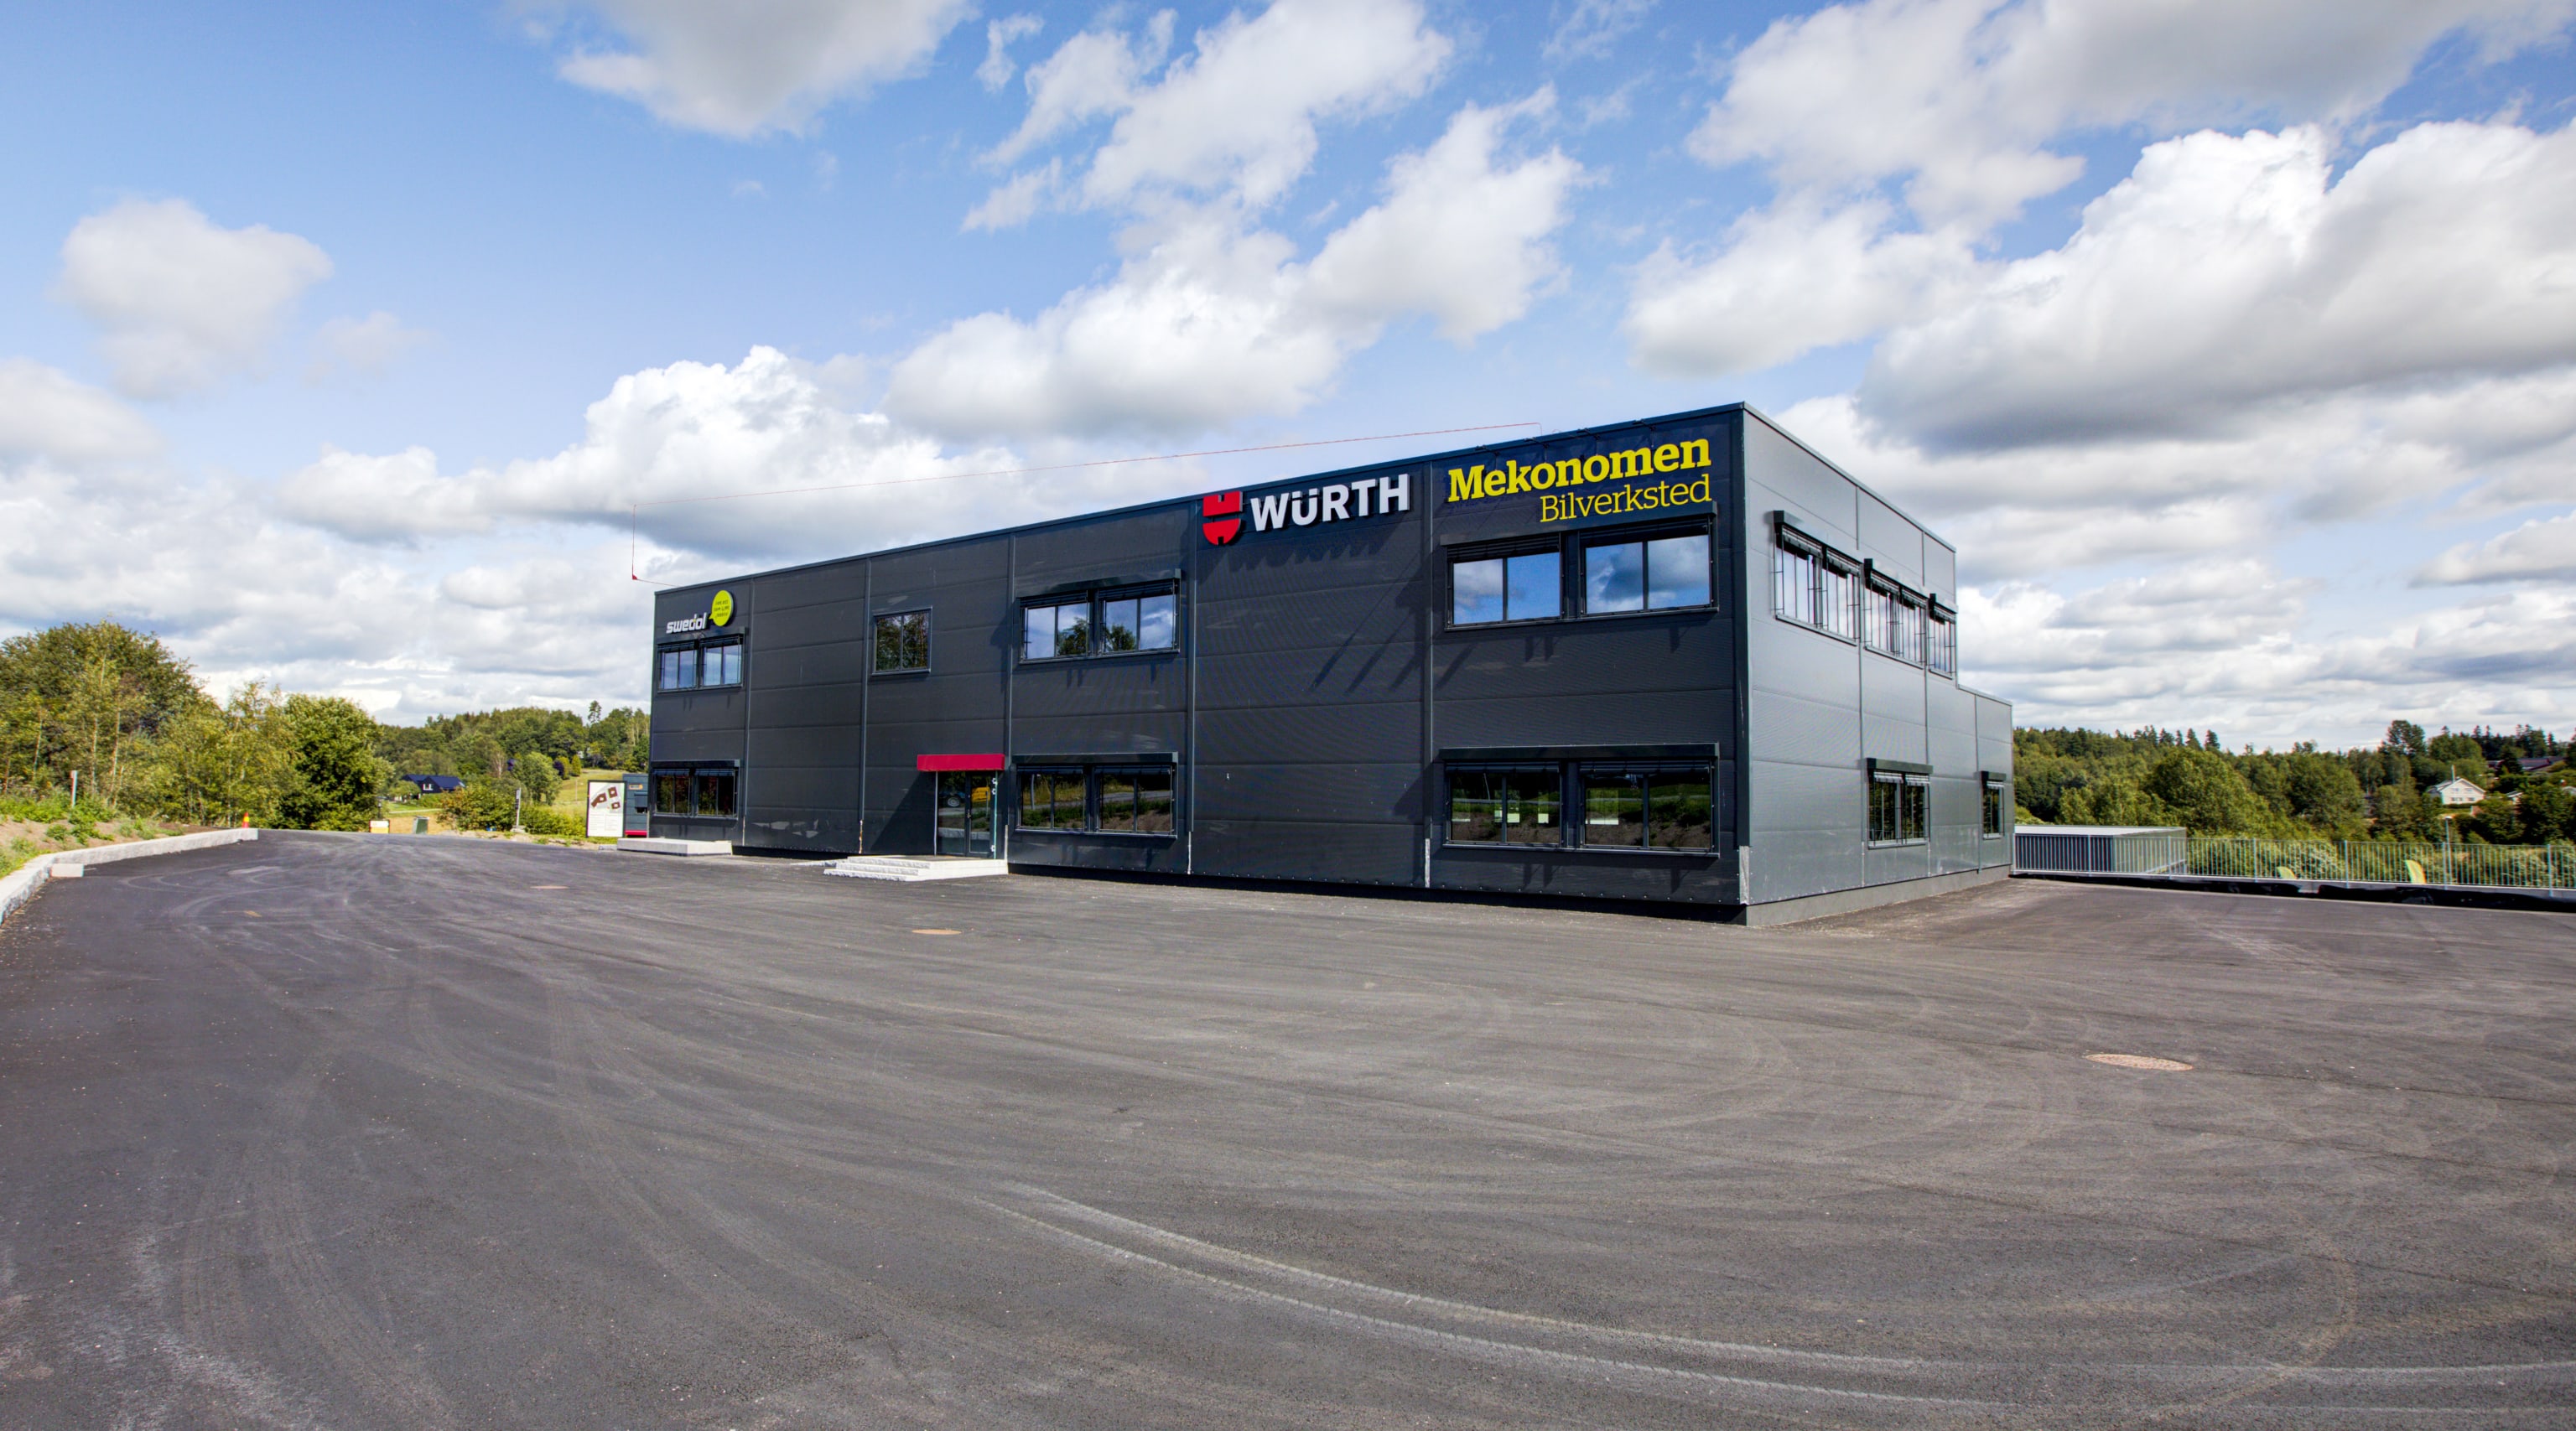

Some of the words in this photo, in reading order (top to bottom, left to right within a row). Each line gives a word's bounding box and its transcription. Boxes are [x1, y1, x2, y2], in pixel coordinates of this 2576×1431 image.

[1447, 438, 1712, 503] Mekonomen
[1539, 473, 1713, 523] Bilverksted
[666, 612, 707, 634] swedol
